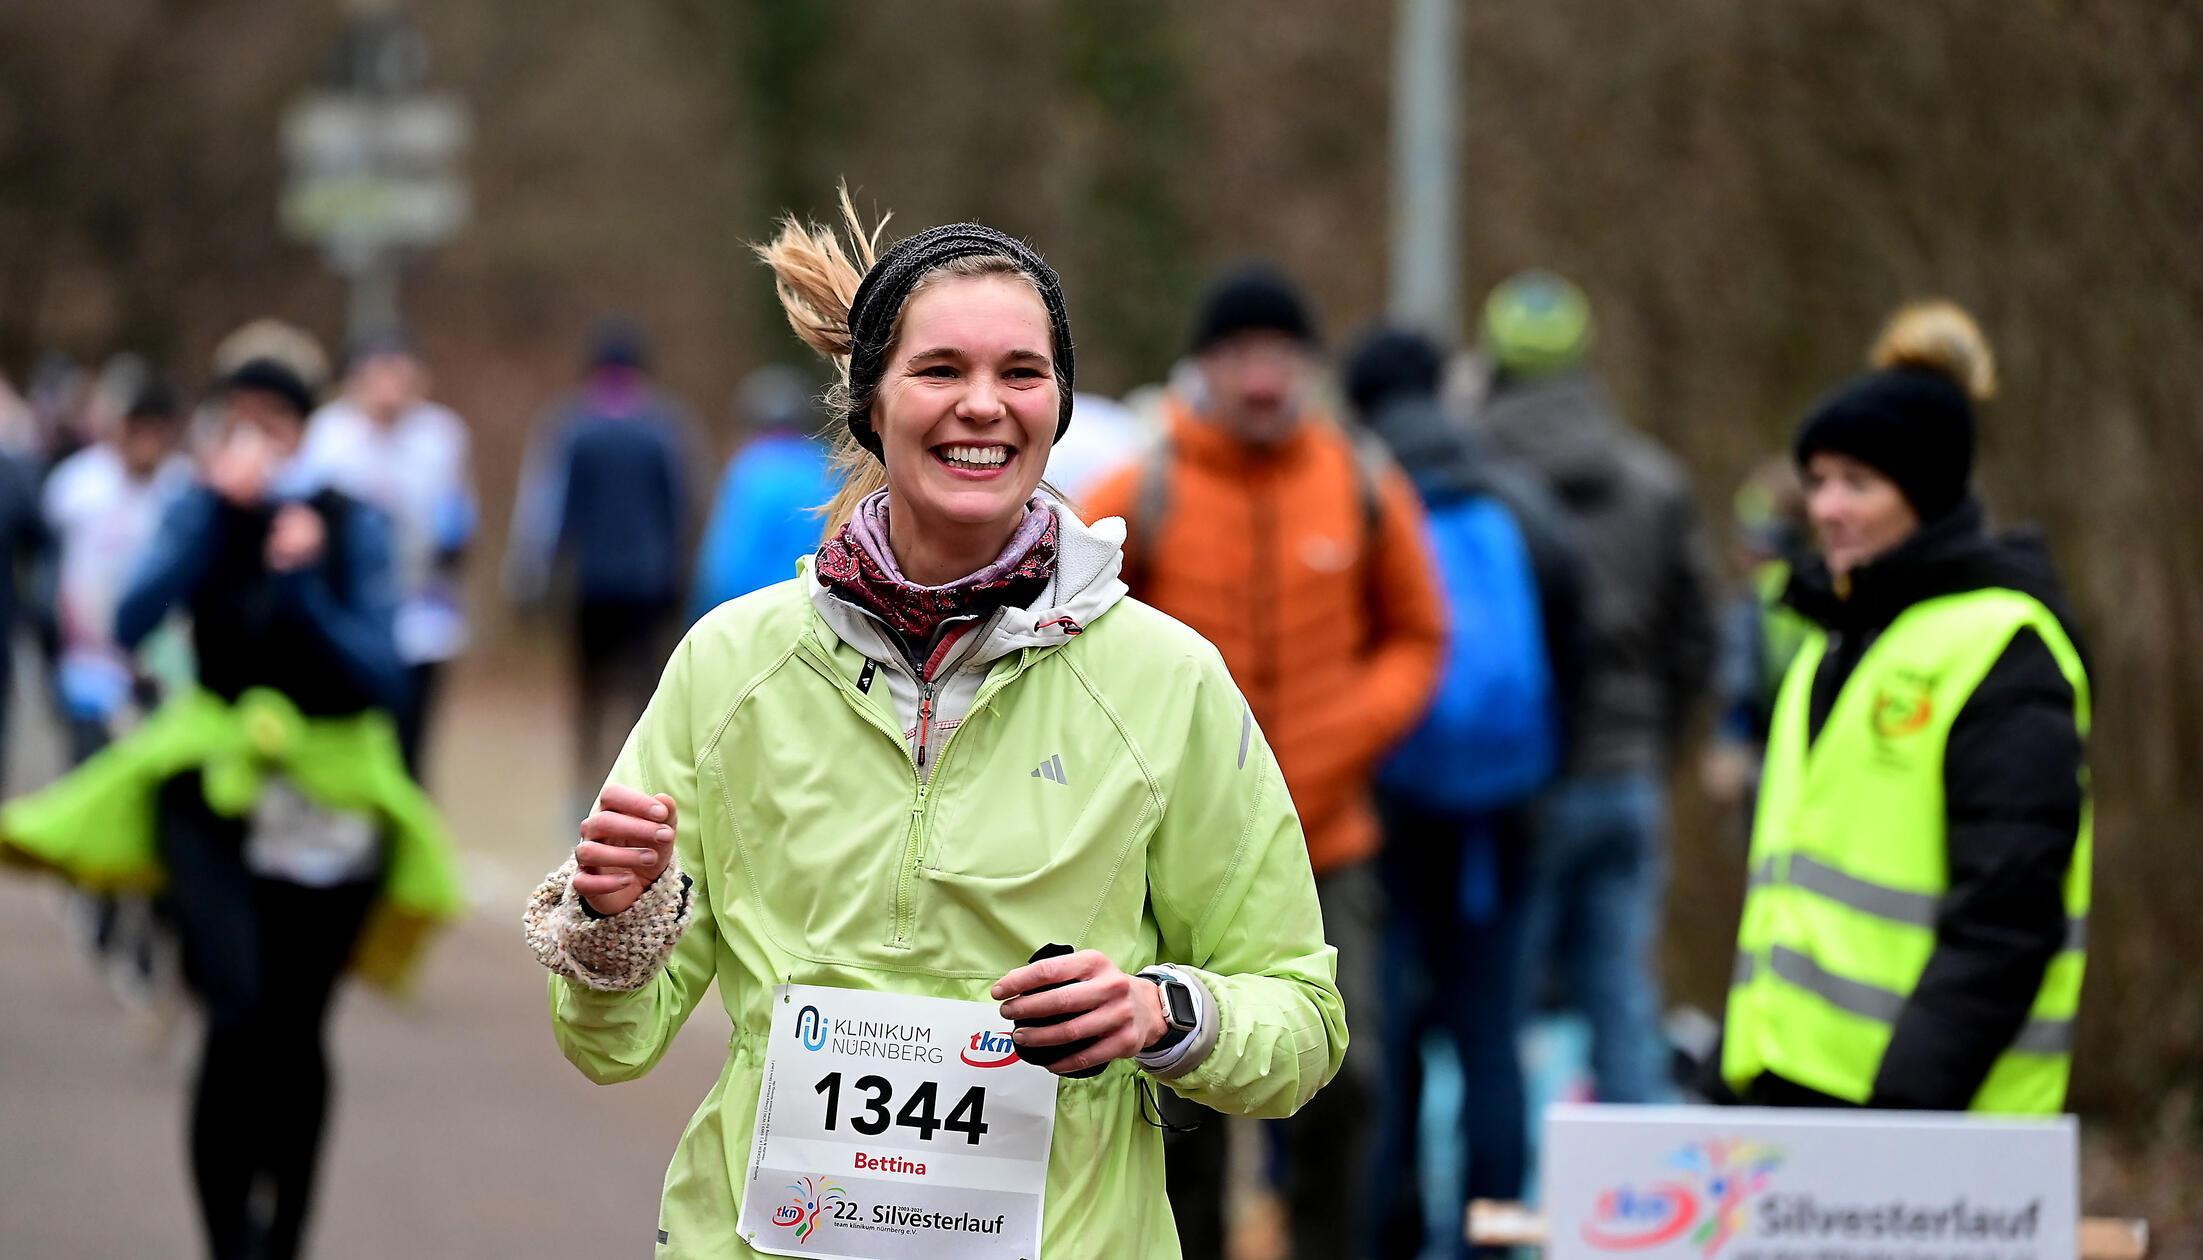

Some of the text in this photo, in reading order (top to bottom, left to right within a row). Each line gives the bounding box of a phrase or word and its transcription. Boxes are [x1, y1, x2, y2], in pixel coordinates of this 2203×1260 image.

[834, 1018, 931, 1043] KLINIKUM
[970, 1030, 1013, 1053] tkn
[832, 1038, 943, 1064] NÜRNBERG
[814, 1072, 989, 1145] 1344
[854, 1152, 927, 1175] Bettina
[776, 1205, 797, 1219] tkn
[833, 1200, 1004, 1234] 22. Silvesterlauf
[1758, 1193, 2043, 1240] Silvesterlauf
[849, 1222, 875, 1231] klinikum
[876, 1225, 905, 1235] nürnberg
